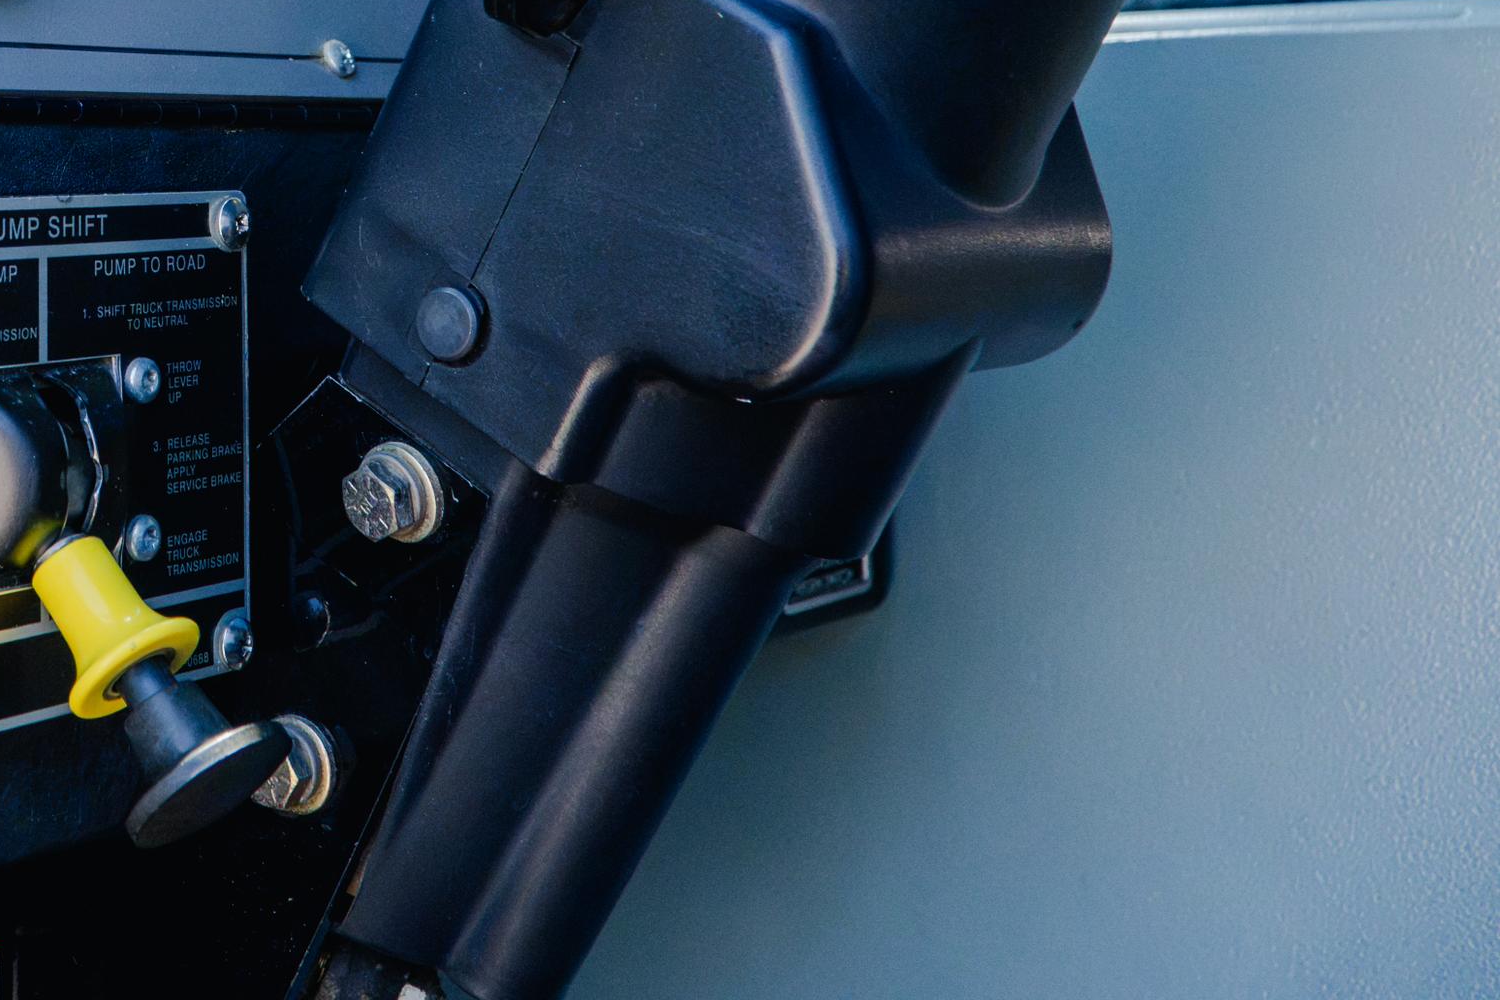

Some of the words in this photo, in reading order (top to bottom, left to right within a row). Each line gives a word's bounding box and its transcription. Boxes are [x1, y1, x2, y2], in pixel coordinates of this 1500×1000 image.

[48, 213, 108, 239] SHIFT
[94, 257, 137, 277] PUMP
[141, 255, 161, 274] TO
[166, 254, 206, 271] ROAD
[97, 304, 126, 319] SHIFT
[130, 300, 163, 315] TRUCK
[167, 294, 238, 312] TRANSMISSION
[127, 318, 141, 331] TO
[144, 314, 189, 329] NEUTRAL
[166, 359, 202, 375] THROW
[168, 374, 199, 389] LEVER
[168, 390, 182, 404] UP
[167, 433, 210, 450] RELEASE
[167, 447, 209, 465] PARKING
[211, 442, 242, 457] BRAKE
[167, 464, 196, 480] APPLY
[167, 476, 208, 494] SERVICE
[211, 471, 242, 488] BRAKE
[167, 529, 208, 548] ENGAGE
[167, 546, 200, 562] TRUCK
[167, 551, 240, 577] TRANSMISSION
